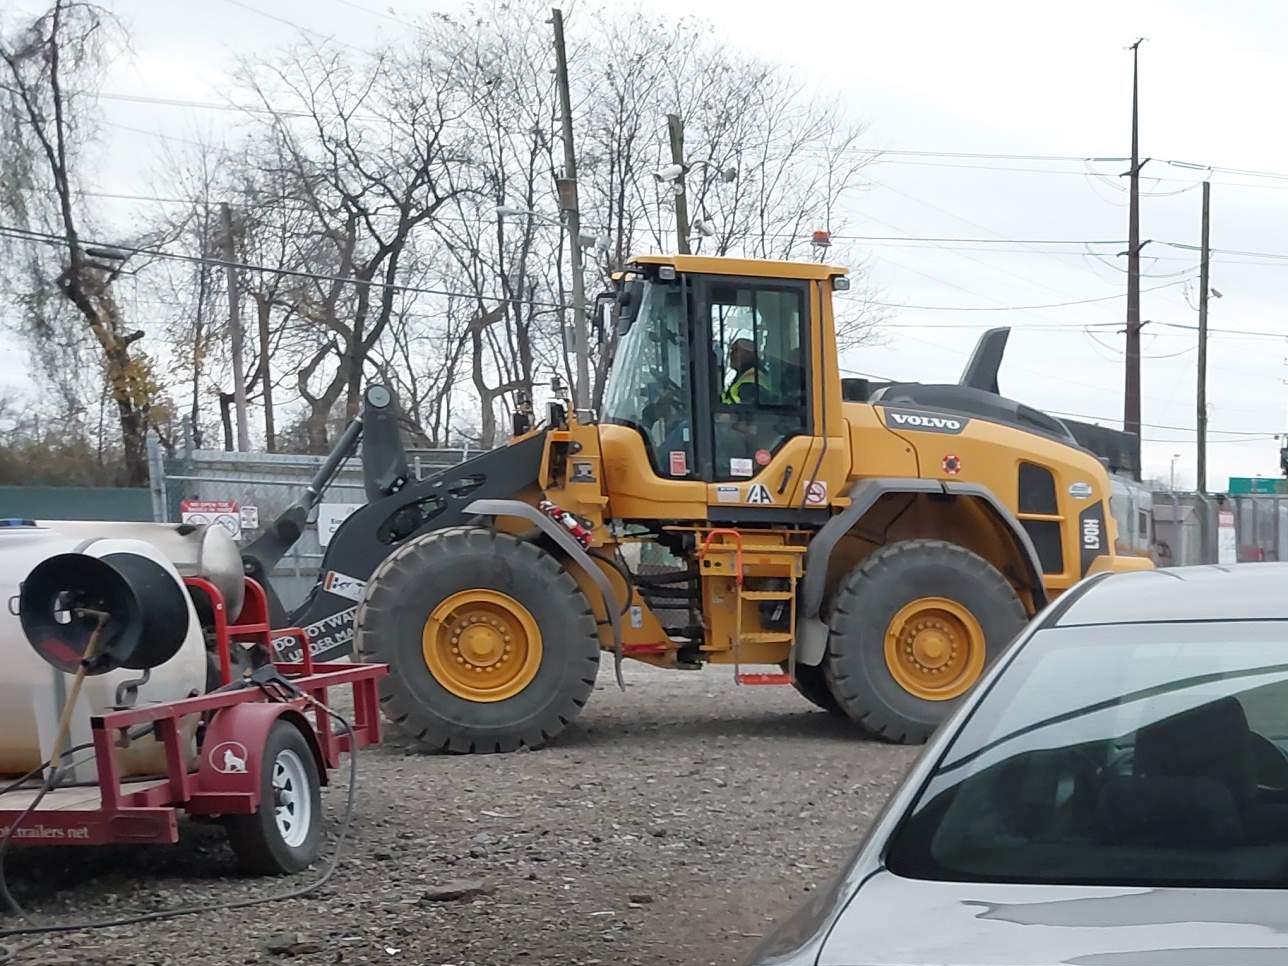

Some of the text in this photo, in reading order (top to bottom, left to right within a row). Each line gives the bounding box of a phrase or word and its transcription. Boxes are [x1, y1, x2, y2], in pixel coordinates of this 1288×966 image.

[891, 413, 961, 430] VOLVO
[1083, 519, 1100, 549] L90H
[273, 635, 296, 652] DO
[328, 610, 356, 628] WAL
[288, 636, 335, 660] UDER
